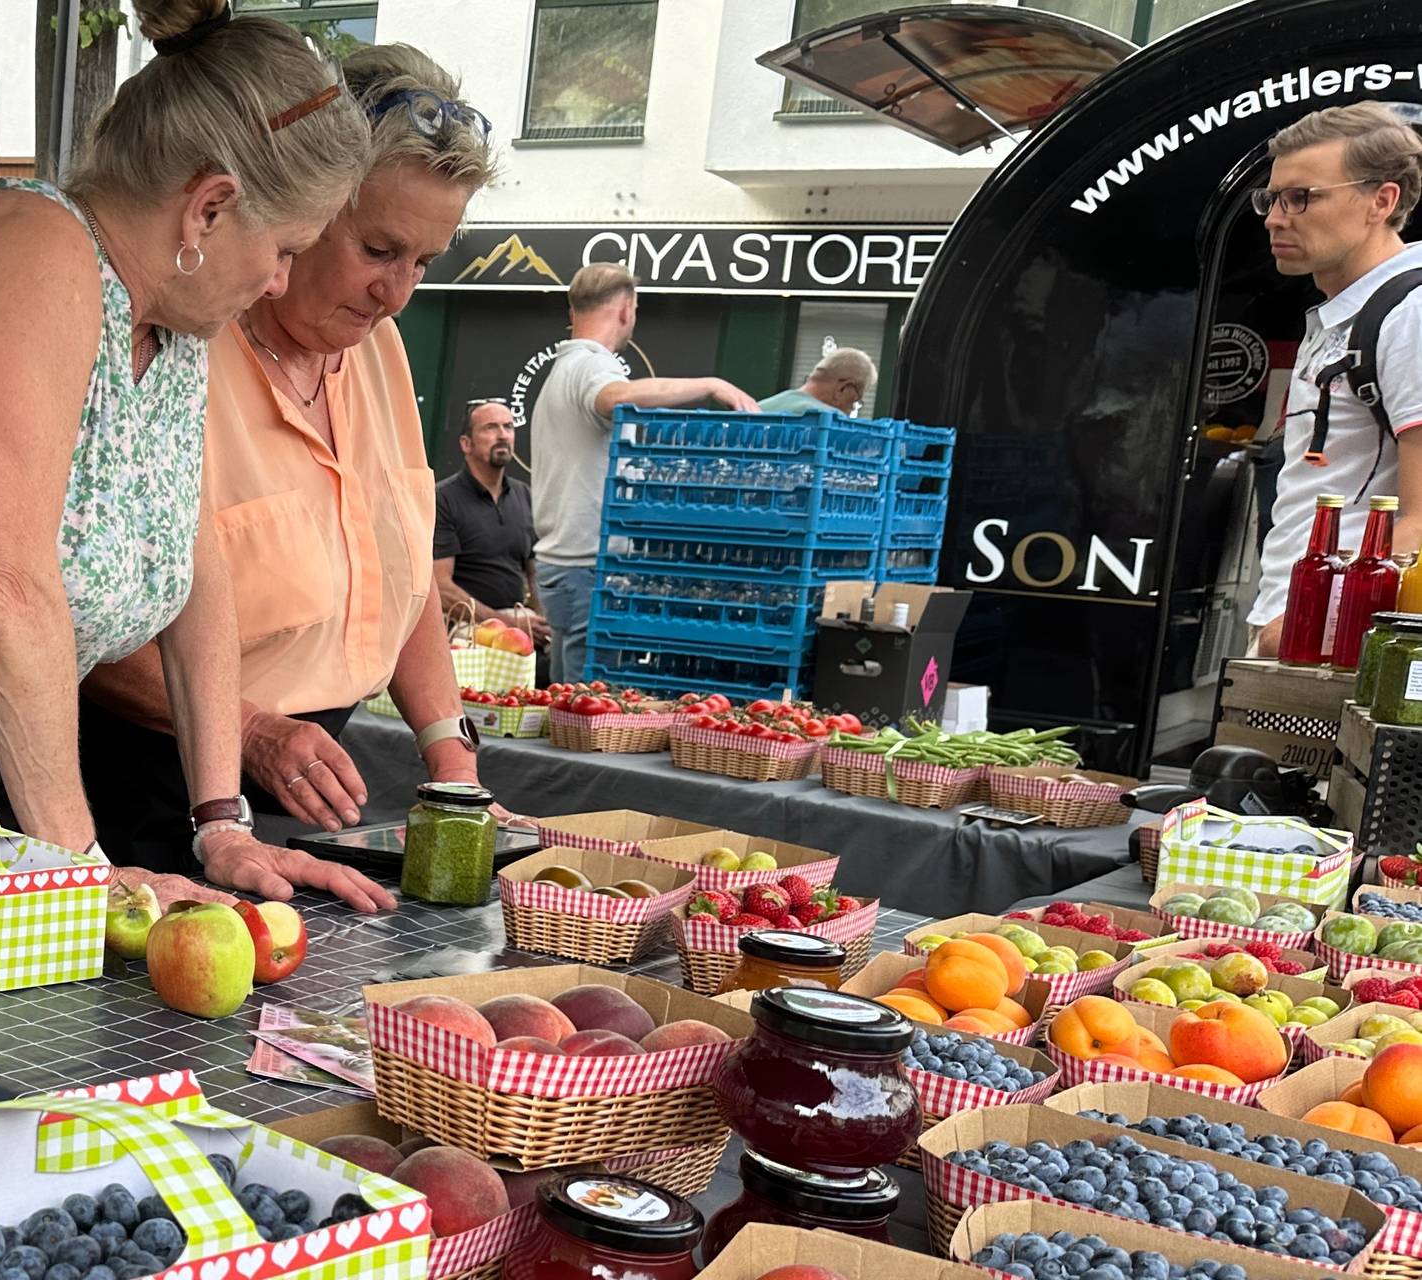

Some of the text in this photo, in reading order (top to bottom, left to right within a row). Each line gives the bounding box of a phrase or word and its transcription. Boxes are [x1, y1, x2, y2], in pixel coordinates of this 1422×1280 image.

[1069, 63, 1422, 215] www.wattlers-
[582, 231, 948, 285] CIYA STORE
[510, 372, 532, 429] ECHTE
[964, 517, 1160, 597] SON
